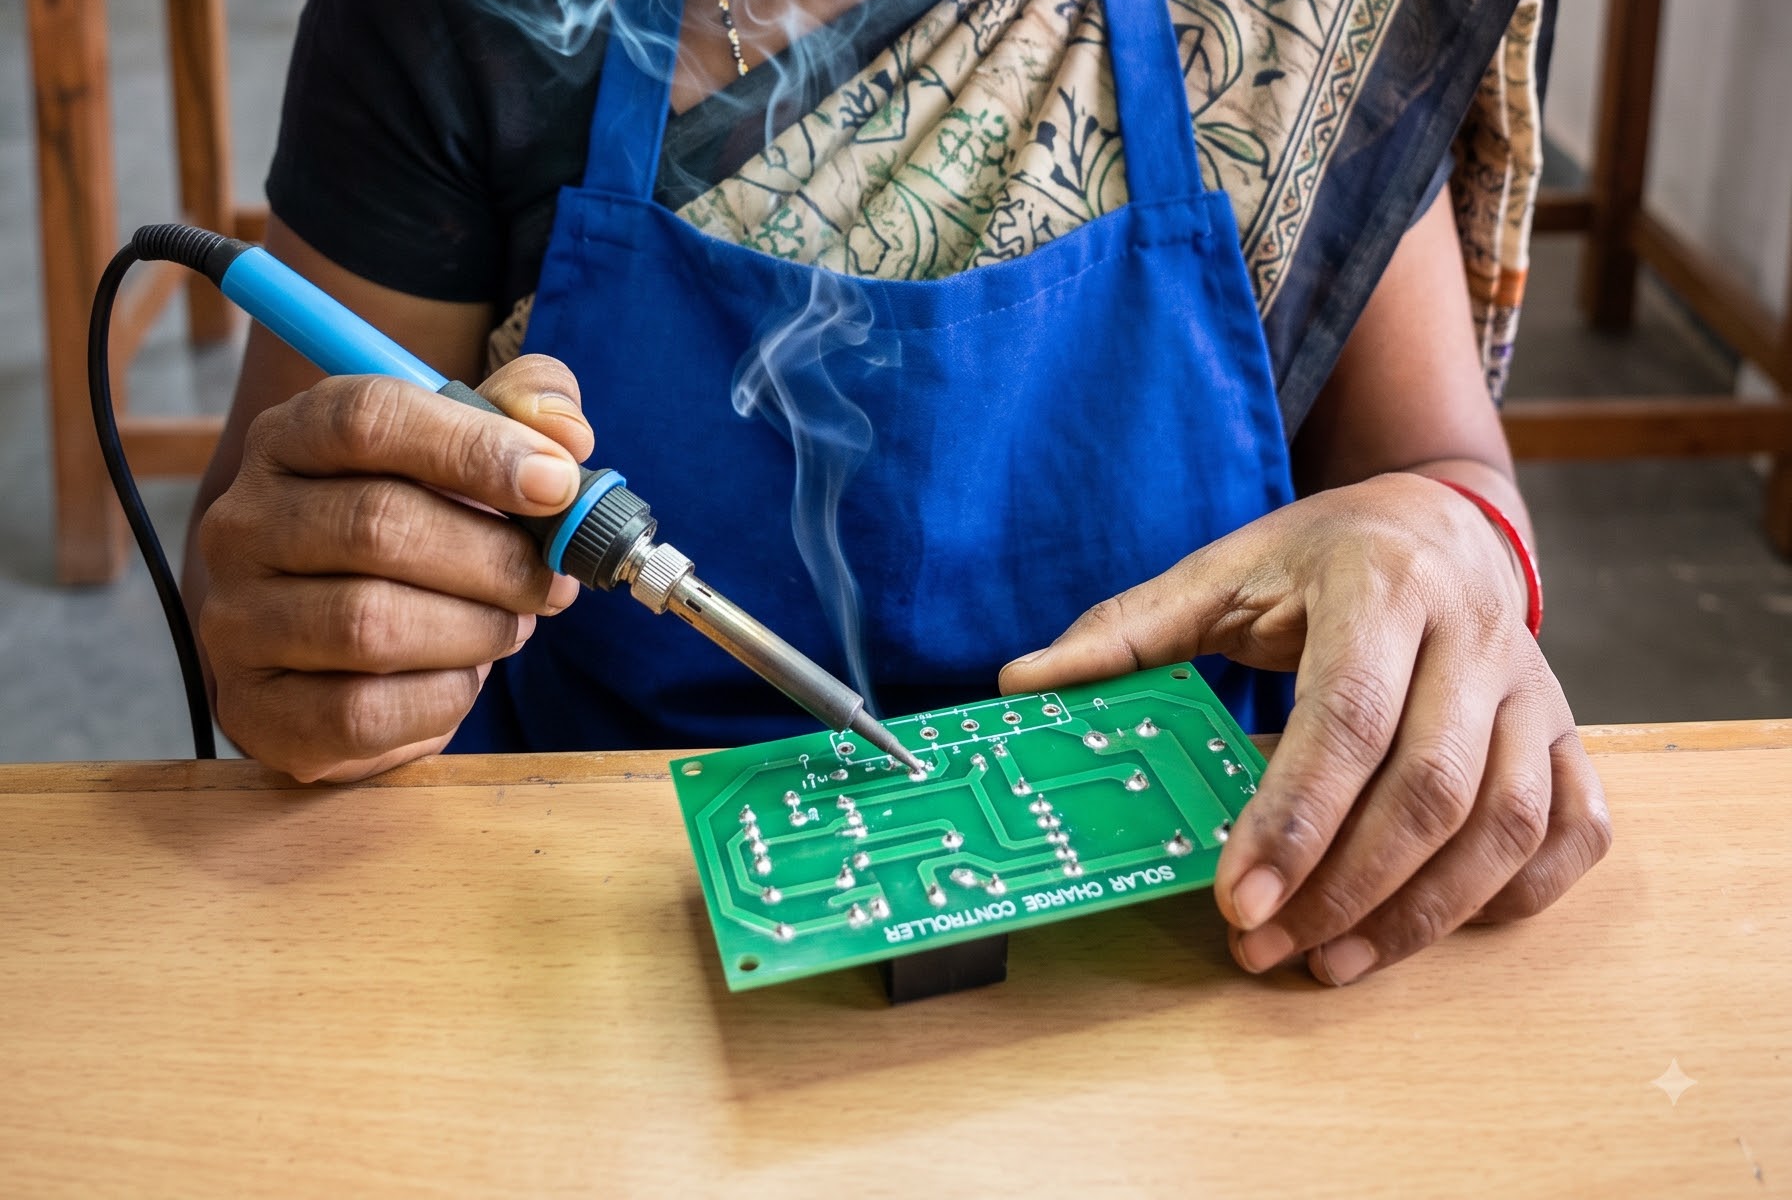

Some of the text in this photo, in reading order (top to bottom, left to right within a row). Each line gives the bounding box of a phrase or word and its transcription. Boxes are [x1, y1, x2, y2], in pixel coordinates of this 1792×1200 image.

[883, 865, 1176, 943] SOLAR CHARGE CONTROLLER
